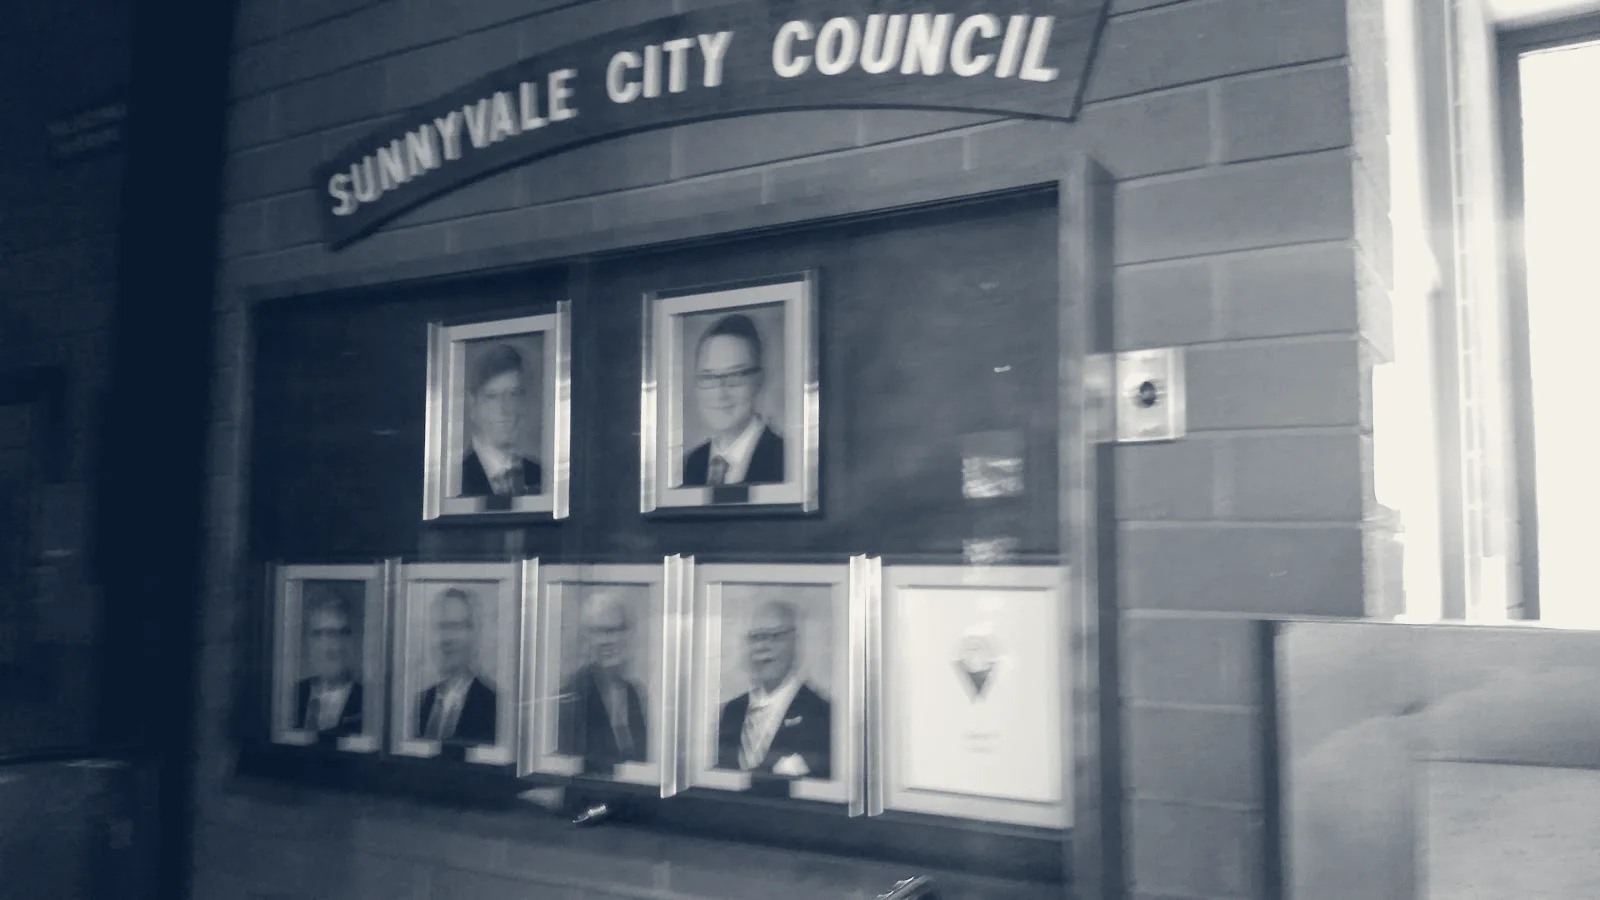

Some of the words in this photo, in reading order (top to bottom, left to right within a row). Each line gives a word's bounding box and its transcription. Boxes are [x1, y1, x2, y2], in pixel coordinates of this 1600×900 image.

[328, 68, 579, 216] SUNNYVALE
[605, 31, 734, 103] CITY
[772, 13, 1060, 82] COUNCIL
